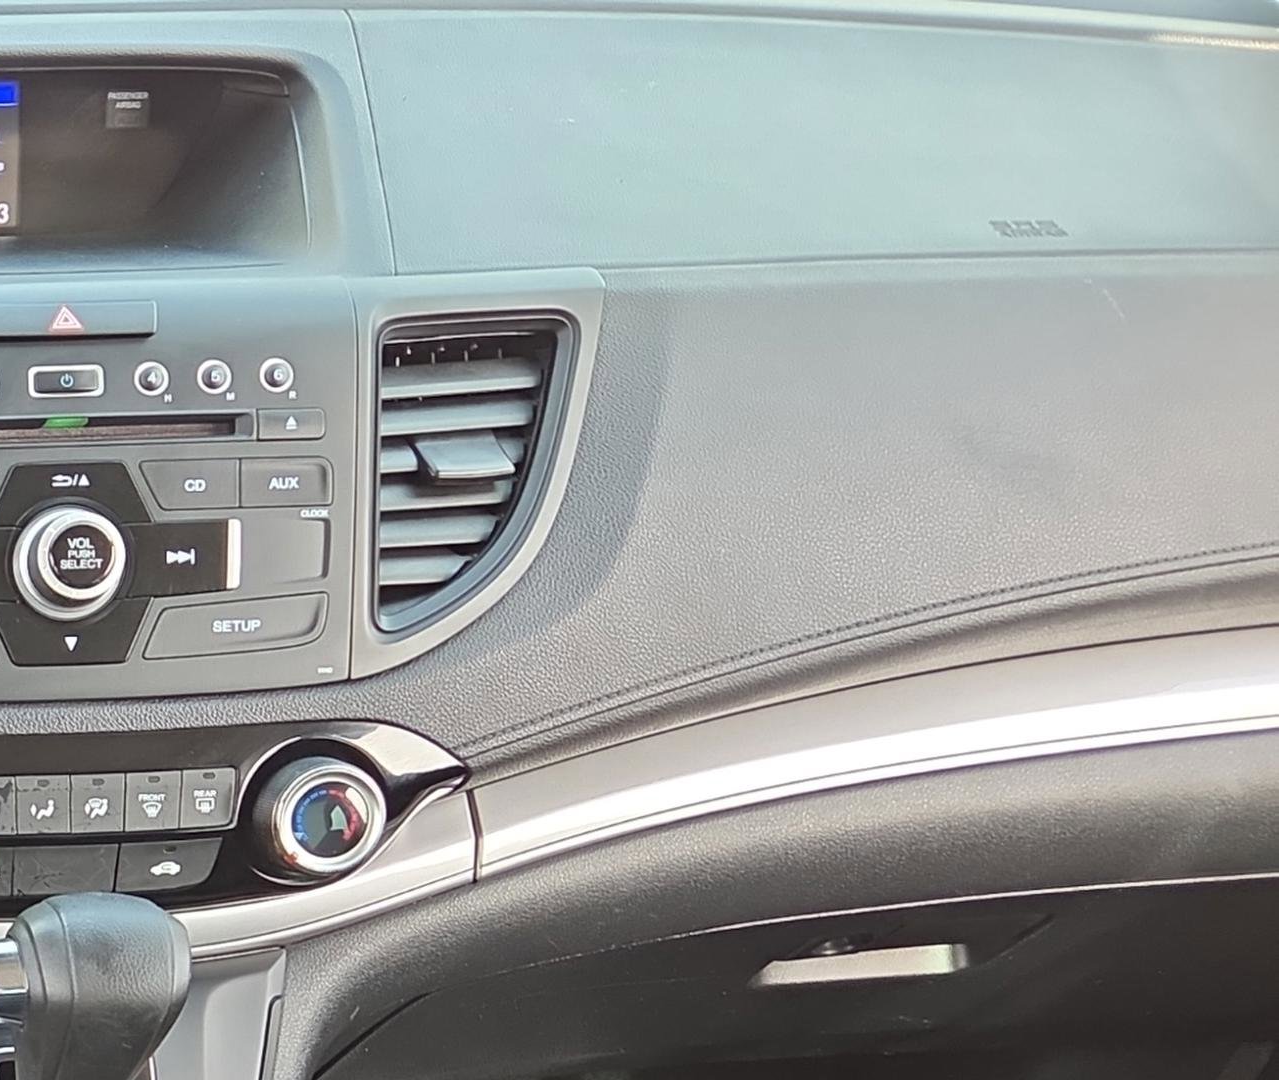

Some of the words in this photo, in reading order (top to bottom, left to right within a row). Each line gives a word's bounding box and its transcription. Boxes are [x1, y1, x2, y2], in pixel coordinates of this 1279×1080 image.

[146, 372, 157, 383] 4
[273, 369, 284, 380] 6
[184, 479, 206, 492] CD
[268, 476, 299, 490] AUX
[67, 537, 94, 550] VOL
[67, 549, 95, 559] PUSH
[59, 558, 104, 570] SELECT
[212, 619, 261, 633] SETUP
[138, 793, 166, 801] FRONT
[193, 789, 217, 797] REAR
